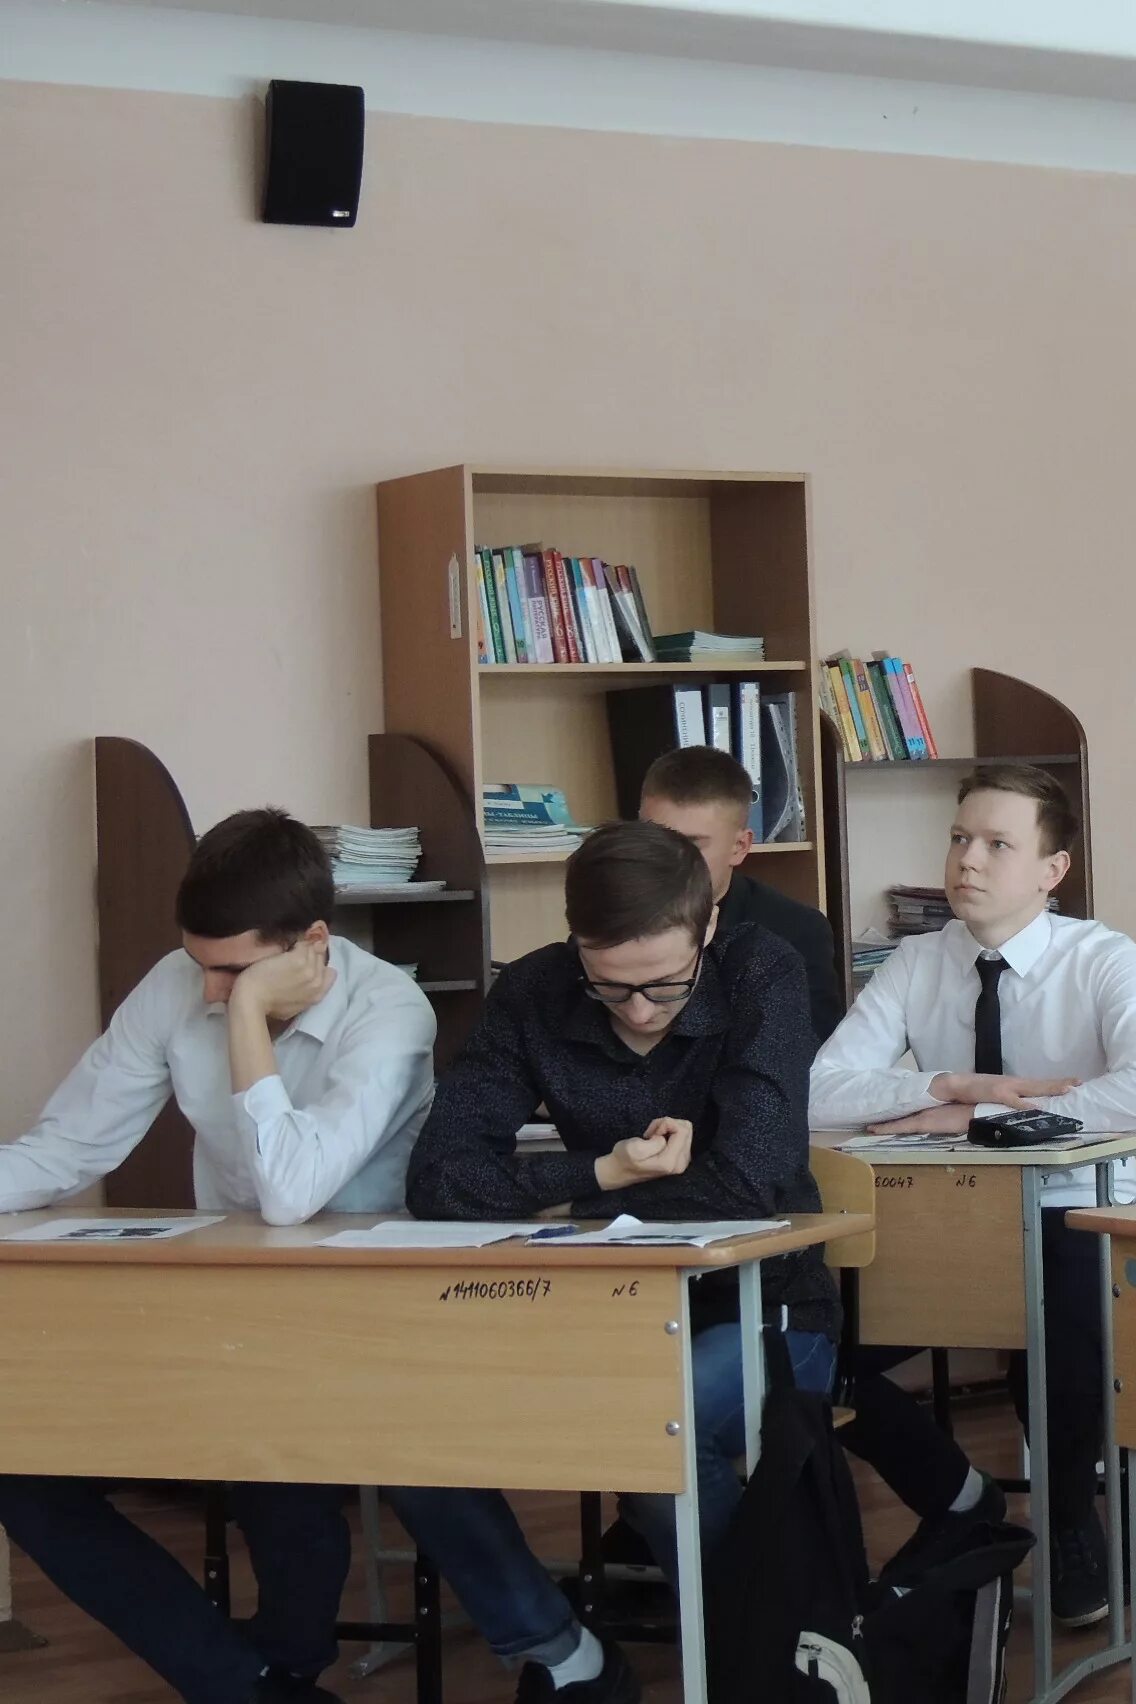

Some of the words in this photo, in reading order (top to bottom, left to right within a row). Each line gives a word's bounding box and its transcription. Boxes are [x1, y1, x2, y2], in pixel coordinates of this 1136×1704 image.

[546, 559, 556, 595] РУССКИЙ
[537, 600, 547, 639] РУССКАЯ
[968, 1175, 977, 1188] 6
[453, 1277, 551, 1302] 1411060366/7
[629, 1280, 640, 1297] 6
